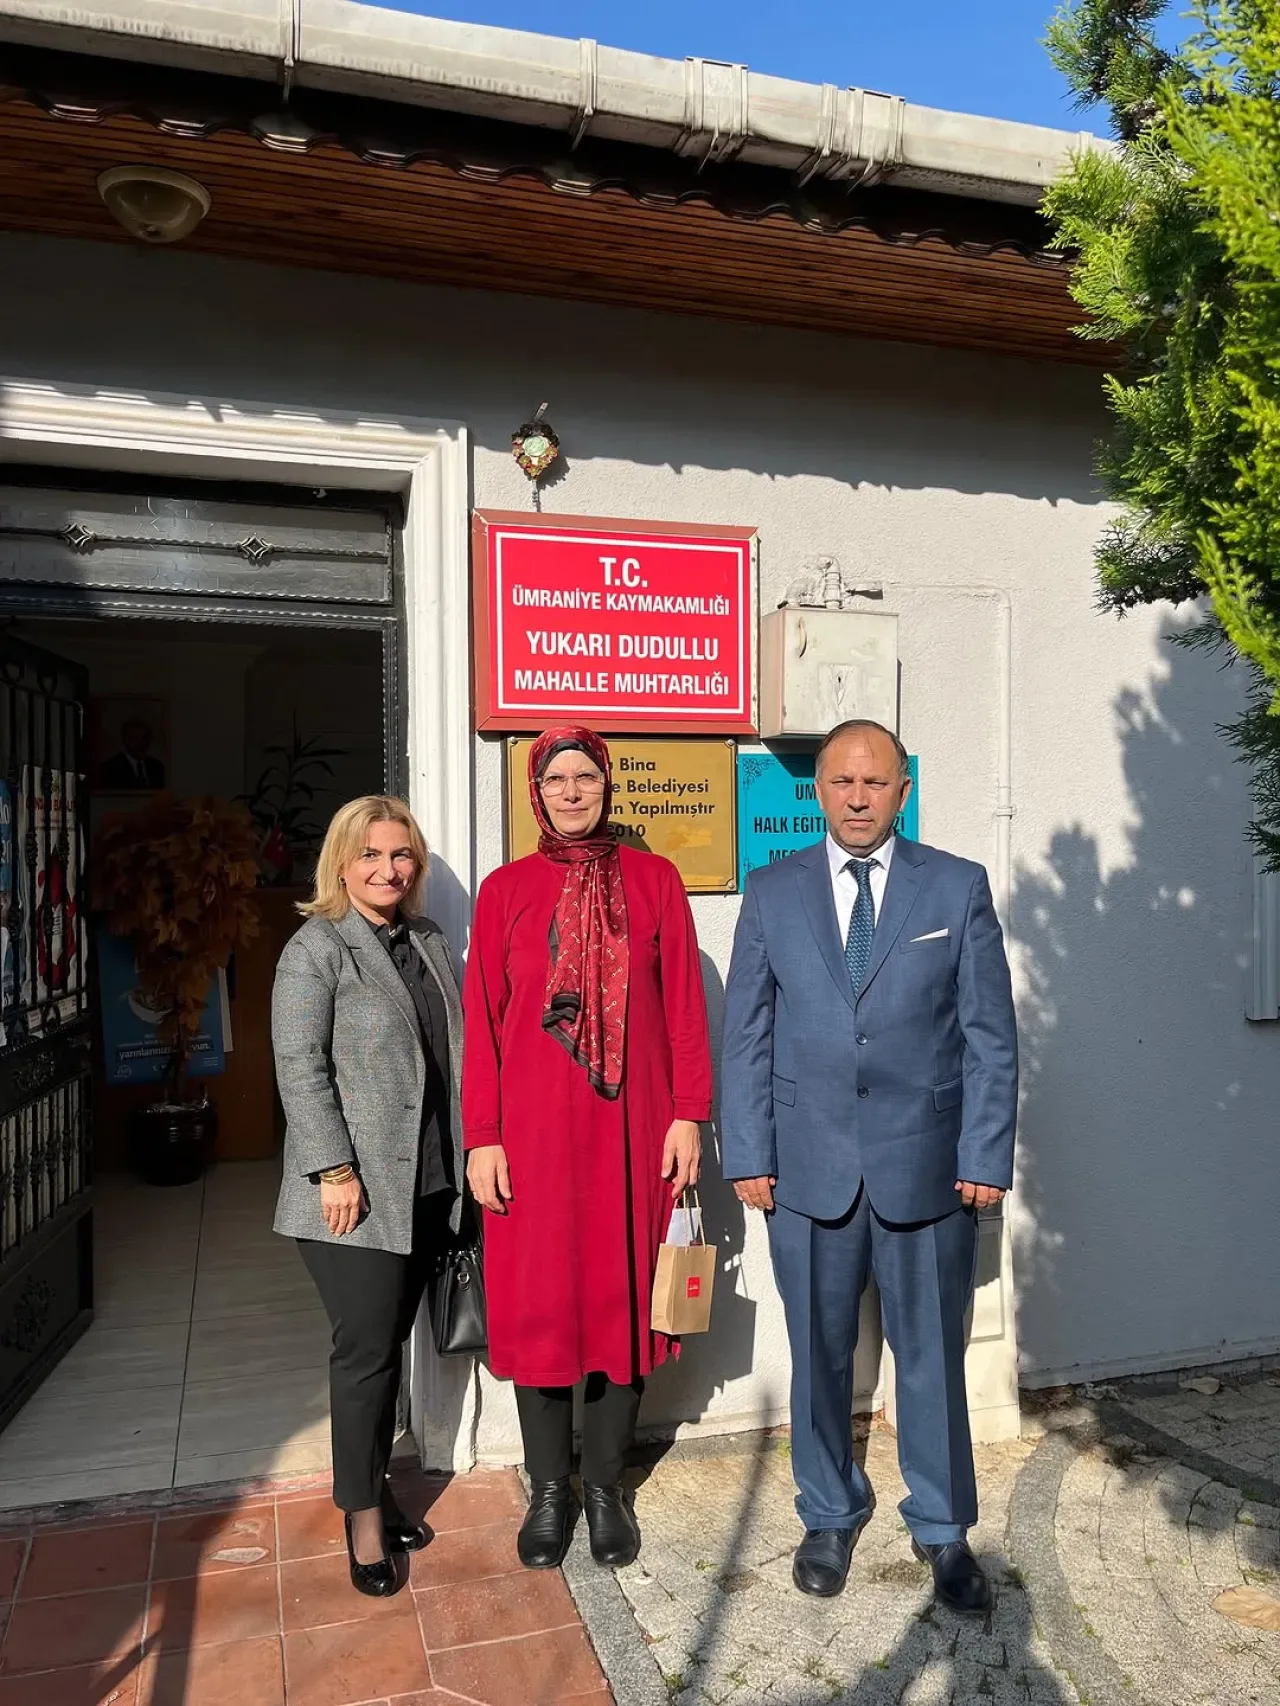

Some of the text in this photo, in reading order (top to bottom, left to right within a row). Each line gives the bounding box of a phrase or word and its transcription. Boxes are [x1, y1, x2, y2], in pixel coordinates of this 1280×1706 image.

[599, 556, 648, 588] T.C.
[512, 584, 730, 616] ÜMRANİYE KAYMAKAMLIĞI
[526, 630, 719, 661] YUKARI DUDULLU
[514, 669, 729, 695] MAHALLE MUHTARLIĞI
[619, 757, 656, 771] Bina
[626, 778, 709, 796] Belediyesi
[628, 800, 715, 818] Yapılmıştır
[754, 816, 788, 833] HALK
